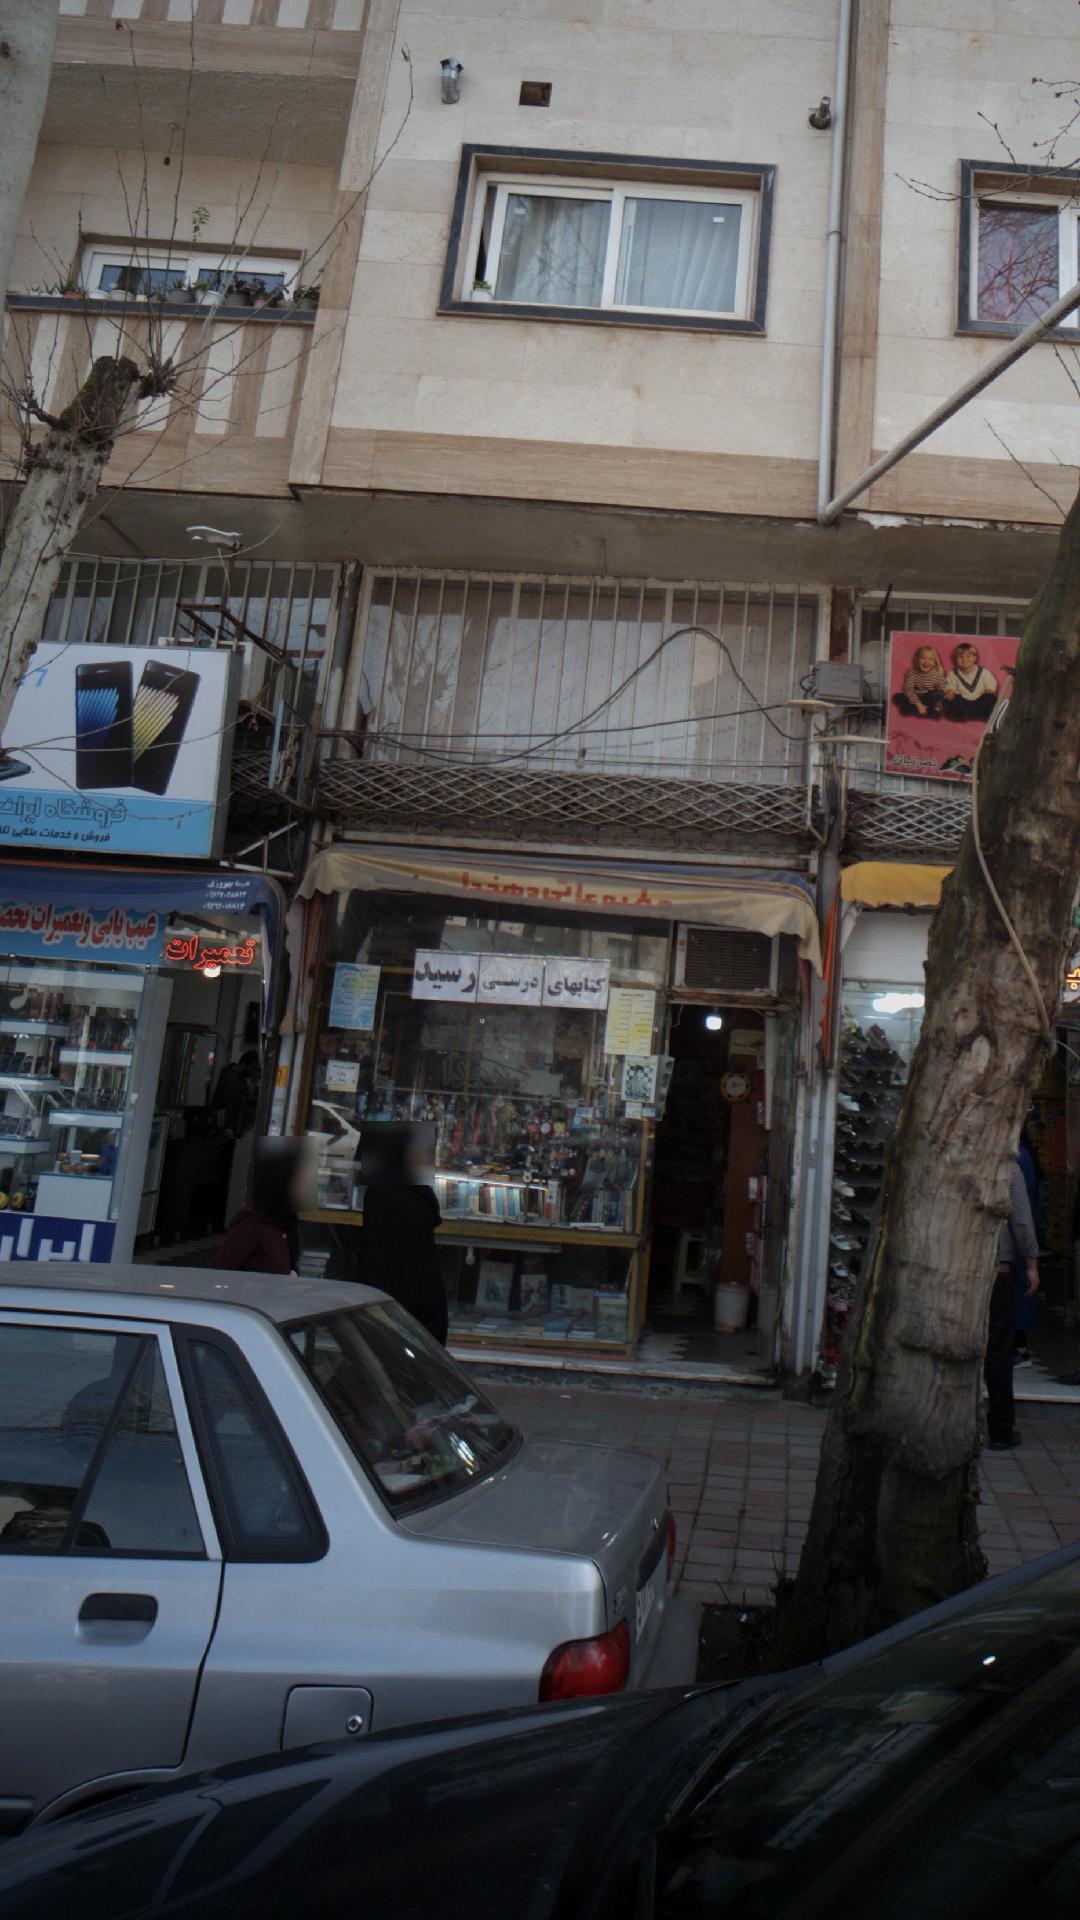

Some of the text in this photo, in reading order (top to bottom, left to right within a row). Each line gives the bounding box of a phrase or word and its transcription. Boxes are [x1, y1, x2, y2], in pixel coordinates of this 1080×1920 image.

[44, 798, 127, 828] فروشگاه
[40, 829, 71, 839] خدمات
[81, 830, 111, 842] فروش
[125, 914, 157, 946] عیب
[165, 934, 256, 970] تعمیرات
[415, 961, 606, 996] کتابهای درسی رسید
